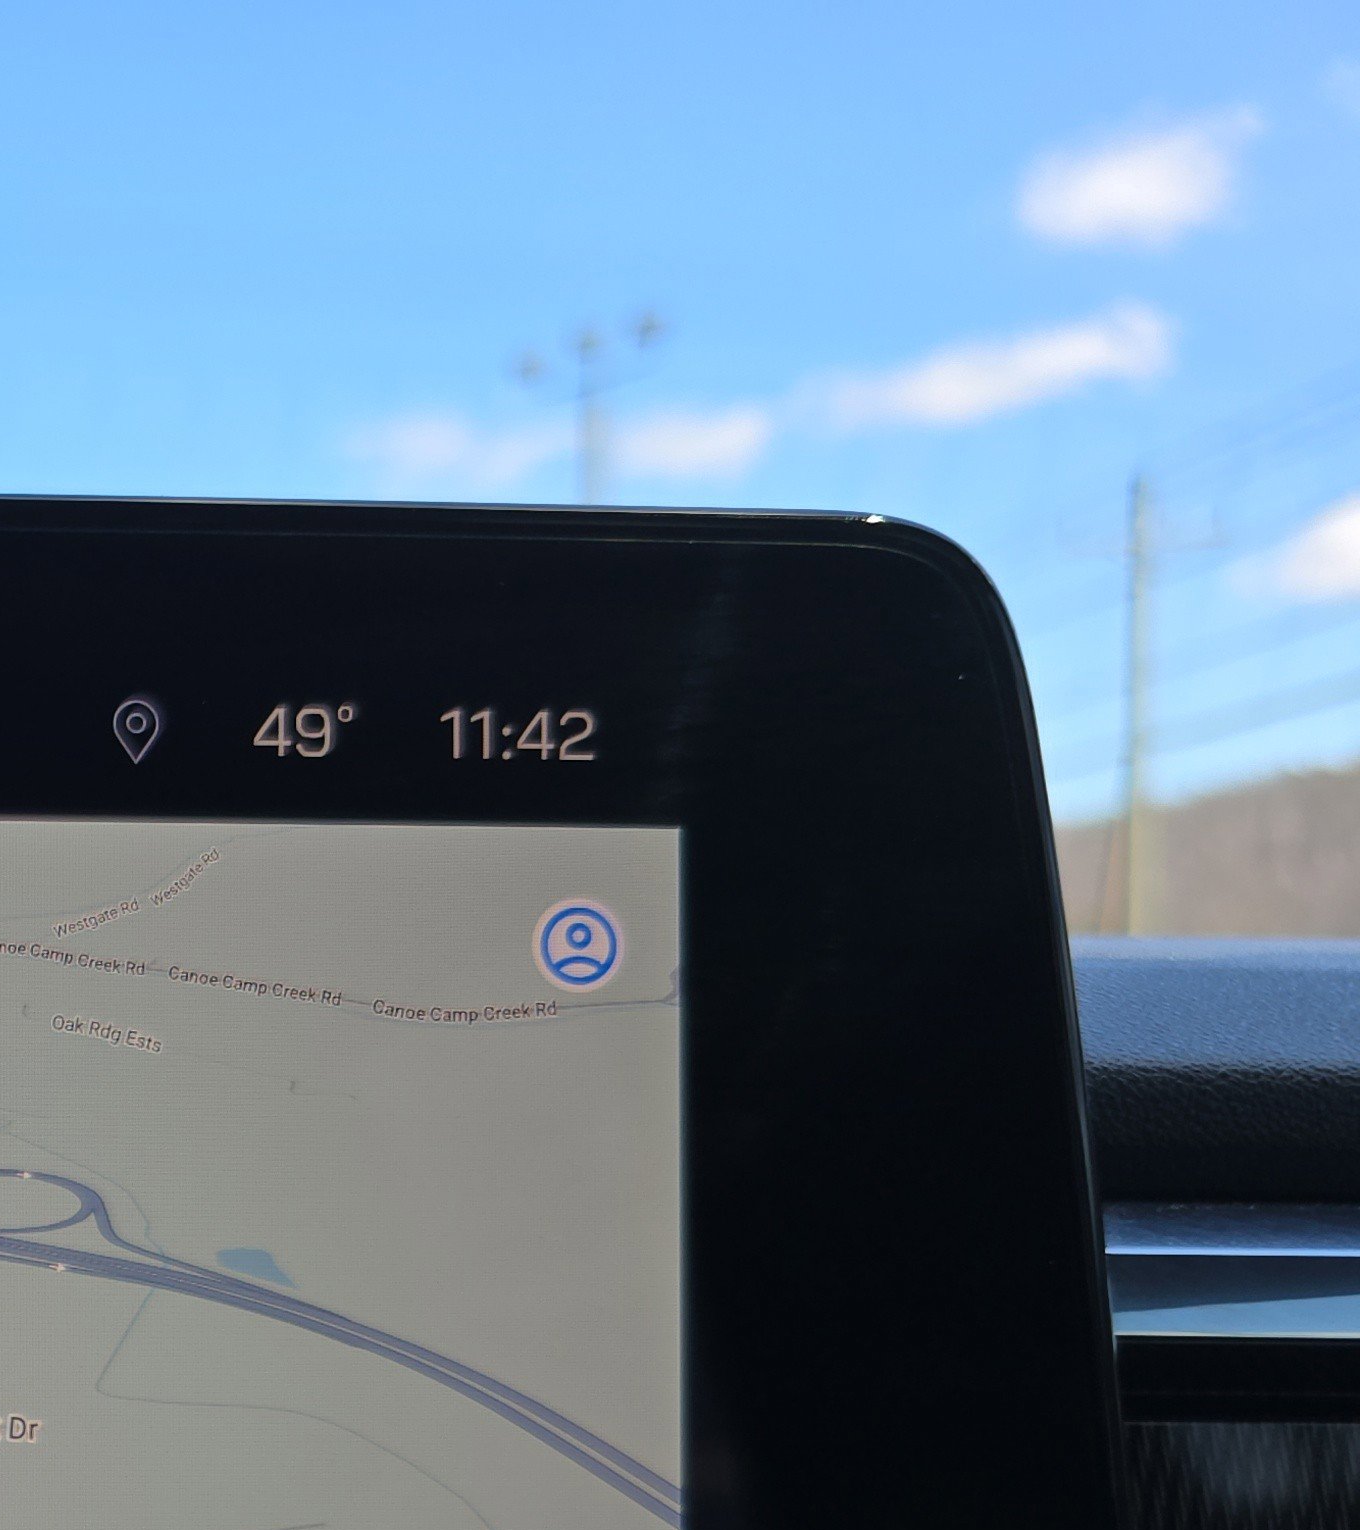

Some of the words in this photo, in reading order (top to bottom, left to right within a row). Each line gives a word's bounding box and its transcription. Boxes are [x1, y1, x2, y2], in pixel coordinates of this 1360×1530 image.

[253, 704, 354, 758] 49°
[440, 708, 595, 760] 11:42
[150, 861, 205, 906] Westgate
[200, 847, 220, 867] Rd
[52, 905, 119, 938] Westgate
[121, 897, 140, 914] Rd
[30, 944, 73, 966] Camp
[78, 953, 121, 974] Creek
[125, 960, 146, 976] Rd
[168, 965, 219, 987] Canoe
[222, 975, 268, 997] Camp
[272, 983, 316, 1003] Creek
[321, 988, 343, 1007] Rd
[372, 999, 427, 1022] Canoe
[430, 1006, 479, 1026] Camp
[483, 1004, 532, 1022] Creek
[535, 1001, 558, 1018] Rd
[52, 1015, 85, 1035] Oak
[88, 1021, 122, 1044] Rdg
[126, 1028, 163, 1053] Ests
[9, 1416, 39, 1441] Dr
